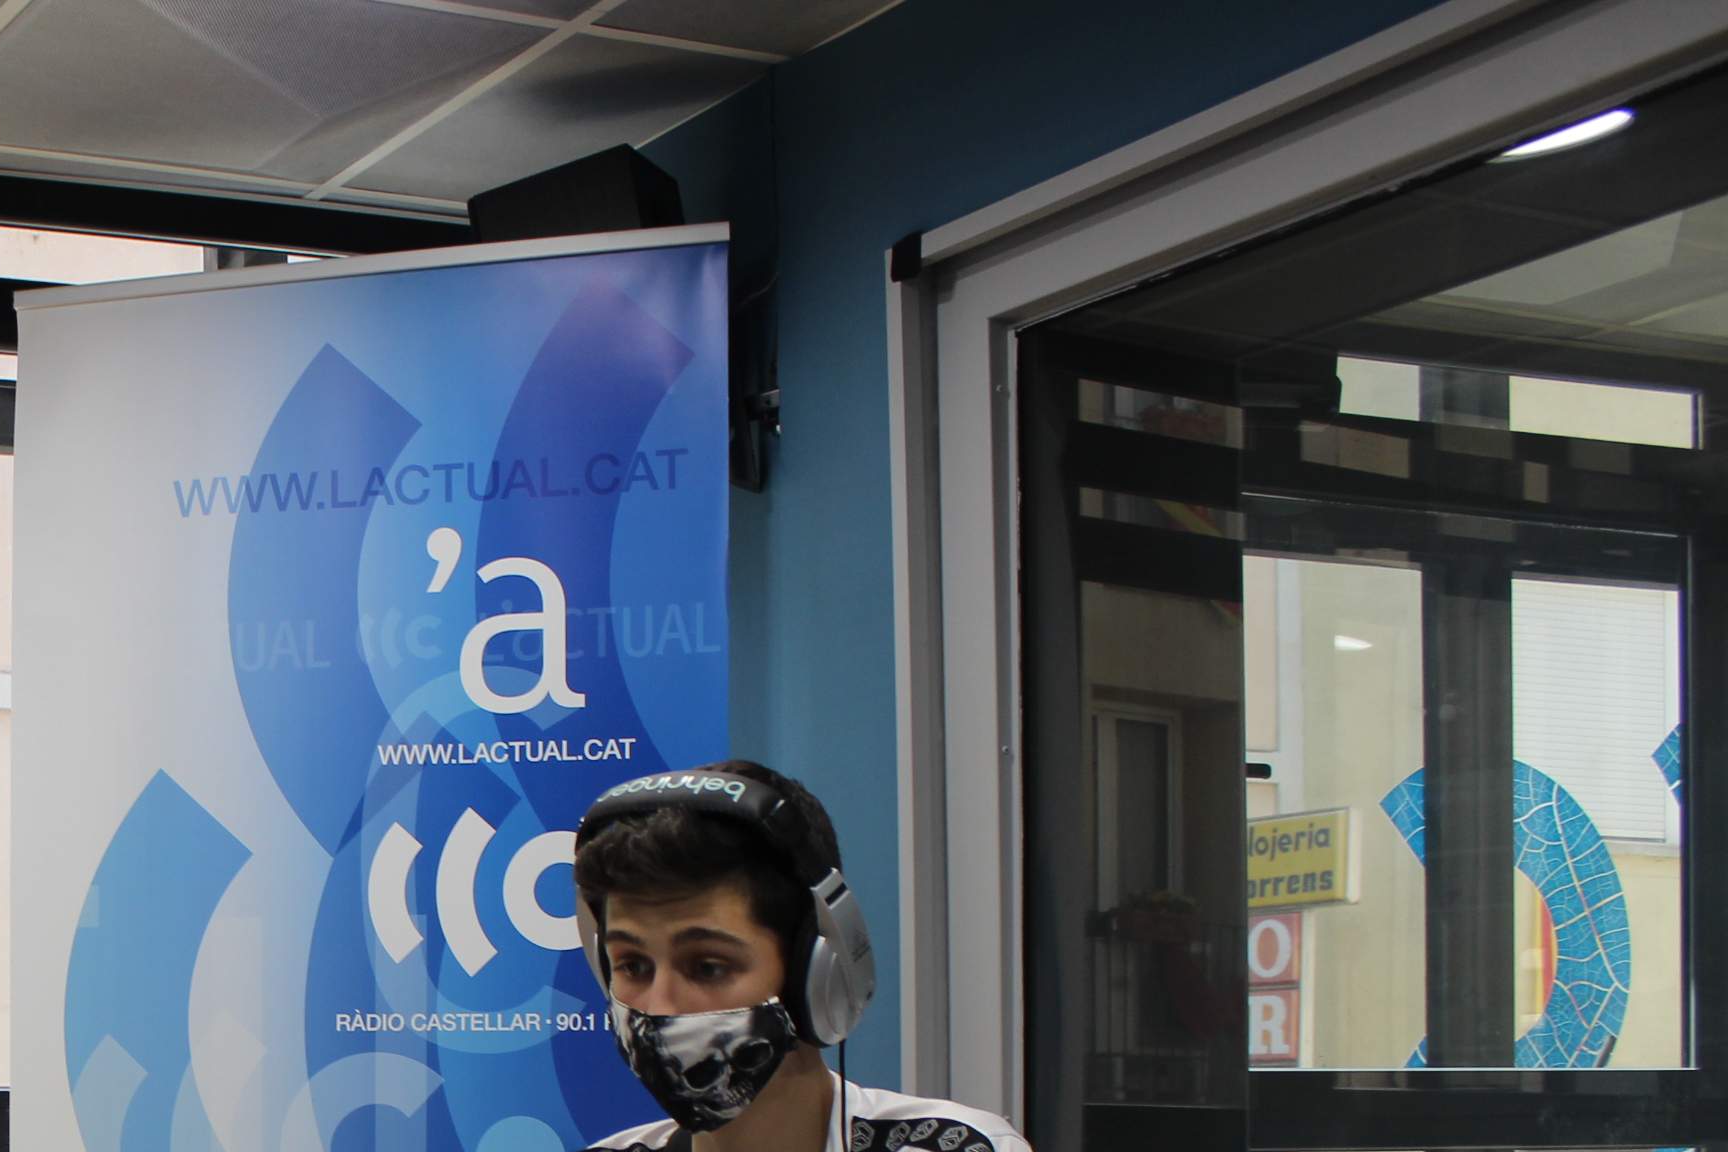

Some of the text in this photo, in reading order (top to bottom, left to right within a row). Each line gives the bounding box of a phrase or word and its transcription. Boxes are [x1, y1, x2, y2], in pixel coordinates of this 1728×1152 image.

[174, 448, 688, 518] WWW.LACTUAL.CAT
[377, 737, 637, 766] WWW.LACTUAL.CAT
[1248, 823, 1331, 861] lojeria
[1248, 868, 1334, 899] orrens
[335, 1009, 405, 1032] RÀDIO
[410, 1013, 541, 1032] CASTELLAR
[556, 1013, 595, 1032] 90.1
